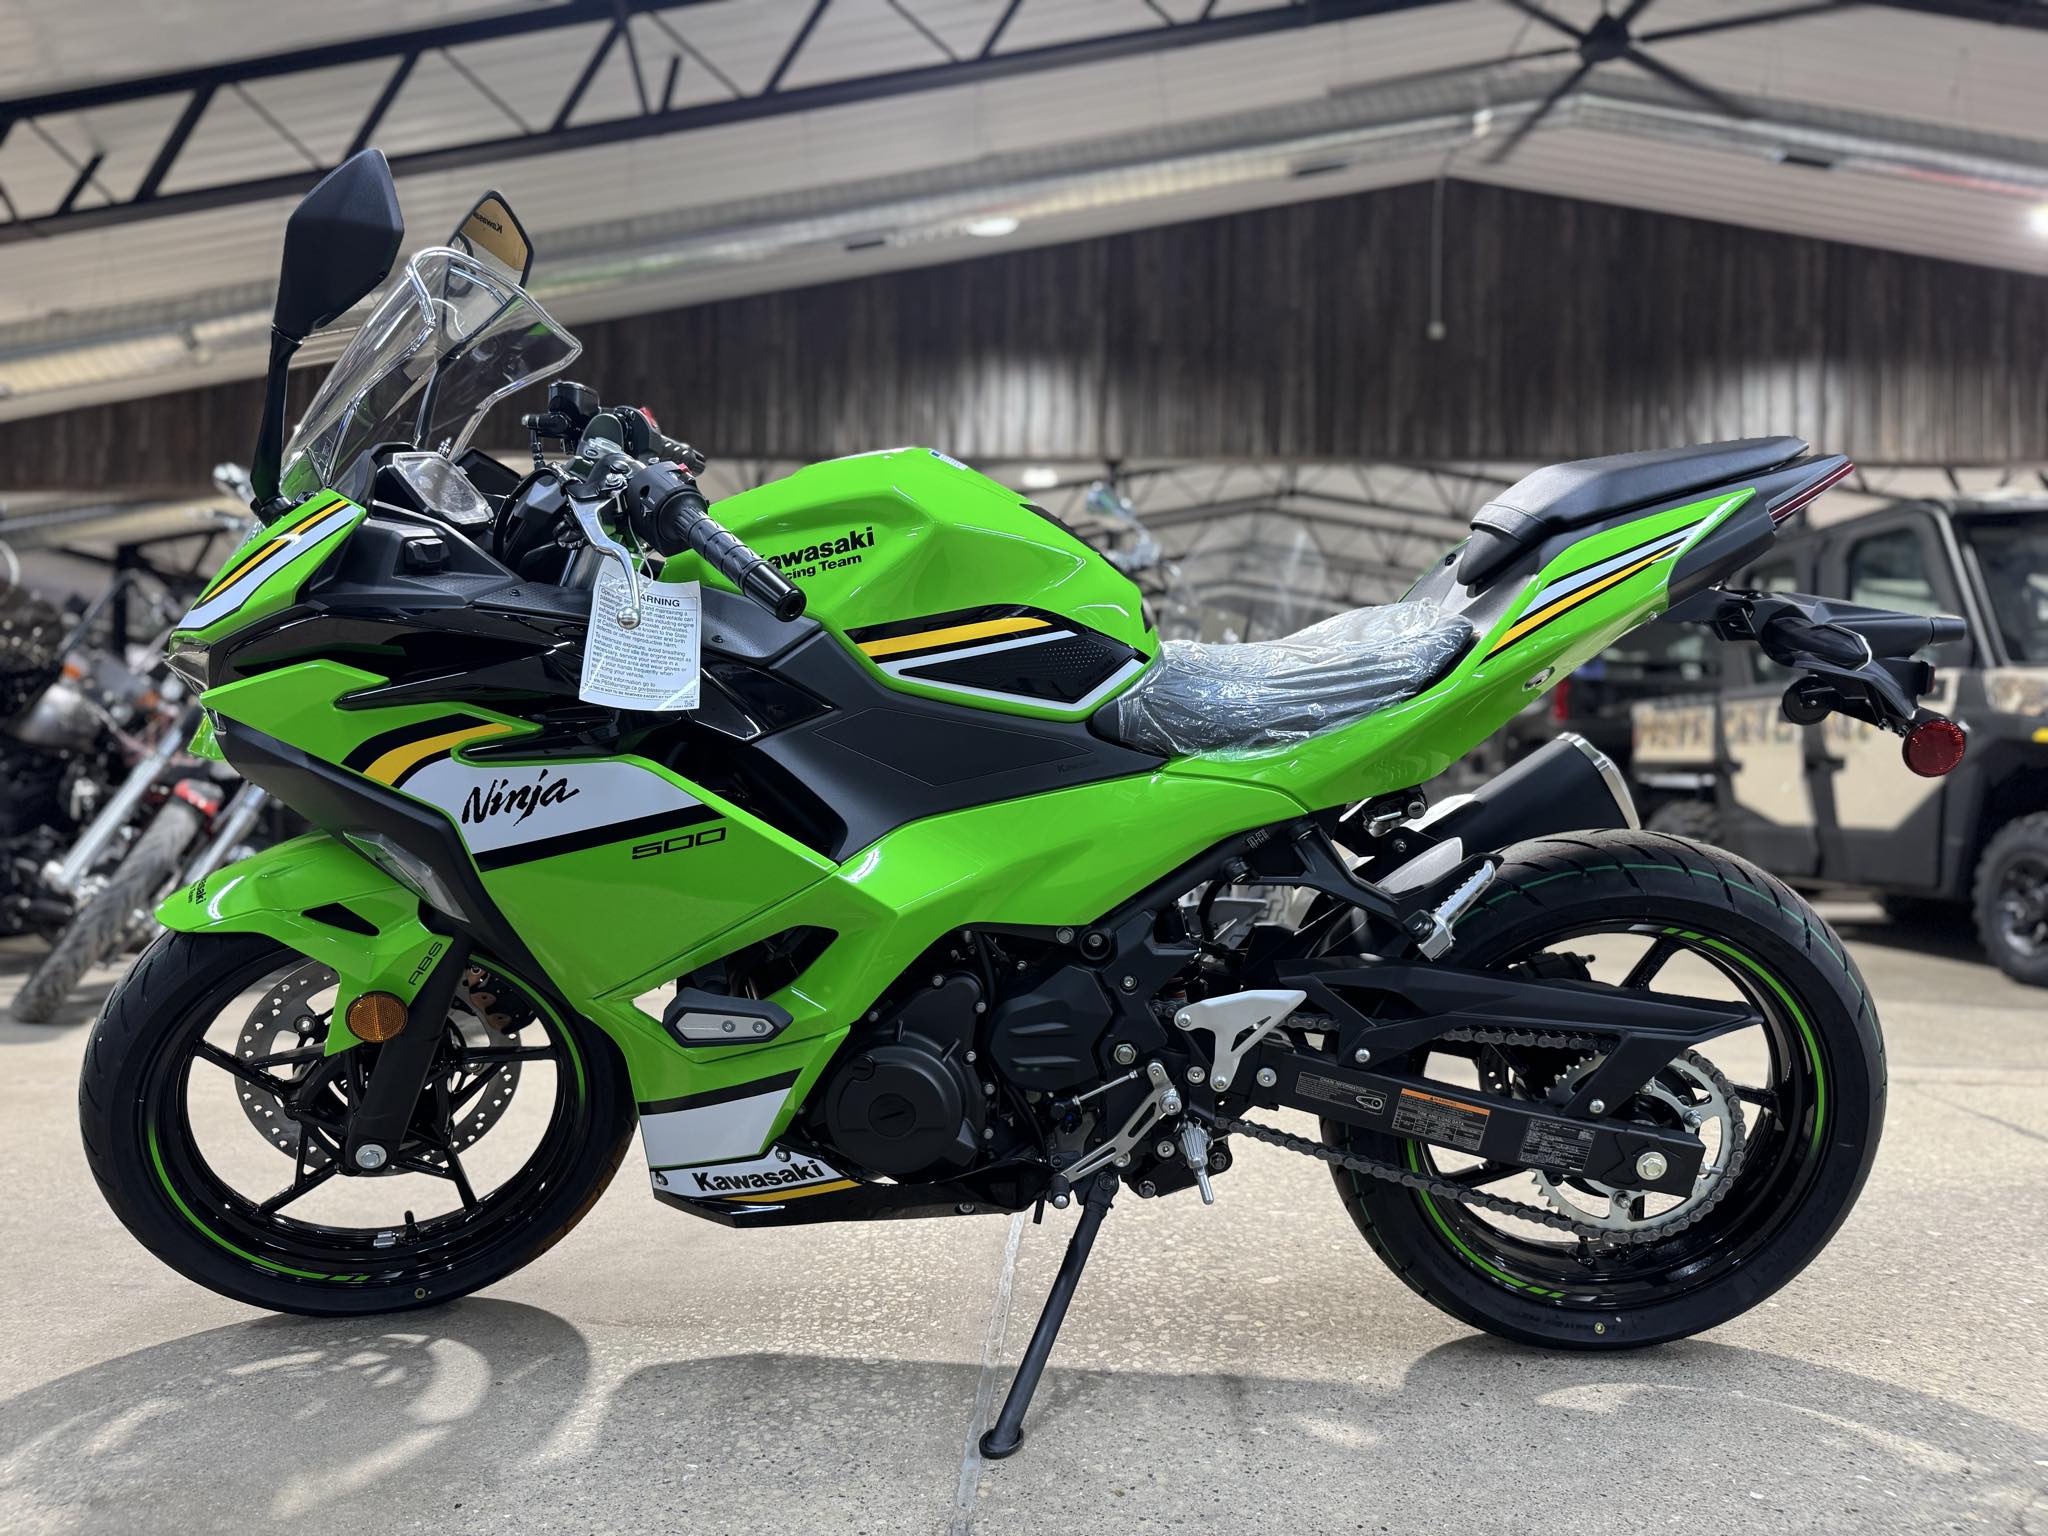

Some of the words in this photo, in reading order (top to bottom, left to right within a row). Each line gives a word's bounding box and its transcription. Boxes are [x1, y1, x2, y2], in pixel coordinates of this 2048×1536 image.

[759, 526, 875, 570] awasaki
[785, 565, 816, 580] cing
[819, 554, 862, 571] Team
[641, 593, 680, 607] ARNING
[462, 768, 580, 827] Ninja
[632, 827, 727, 860] 500
[408, 941, 443, 986] ABS
[691, 1159, 826, 1192] Kawasaki
